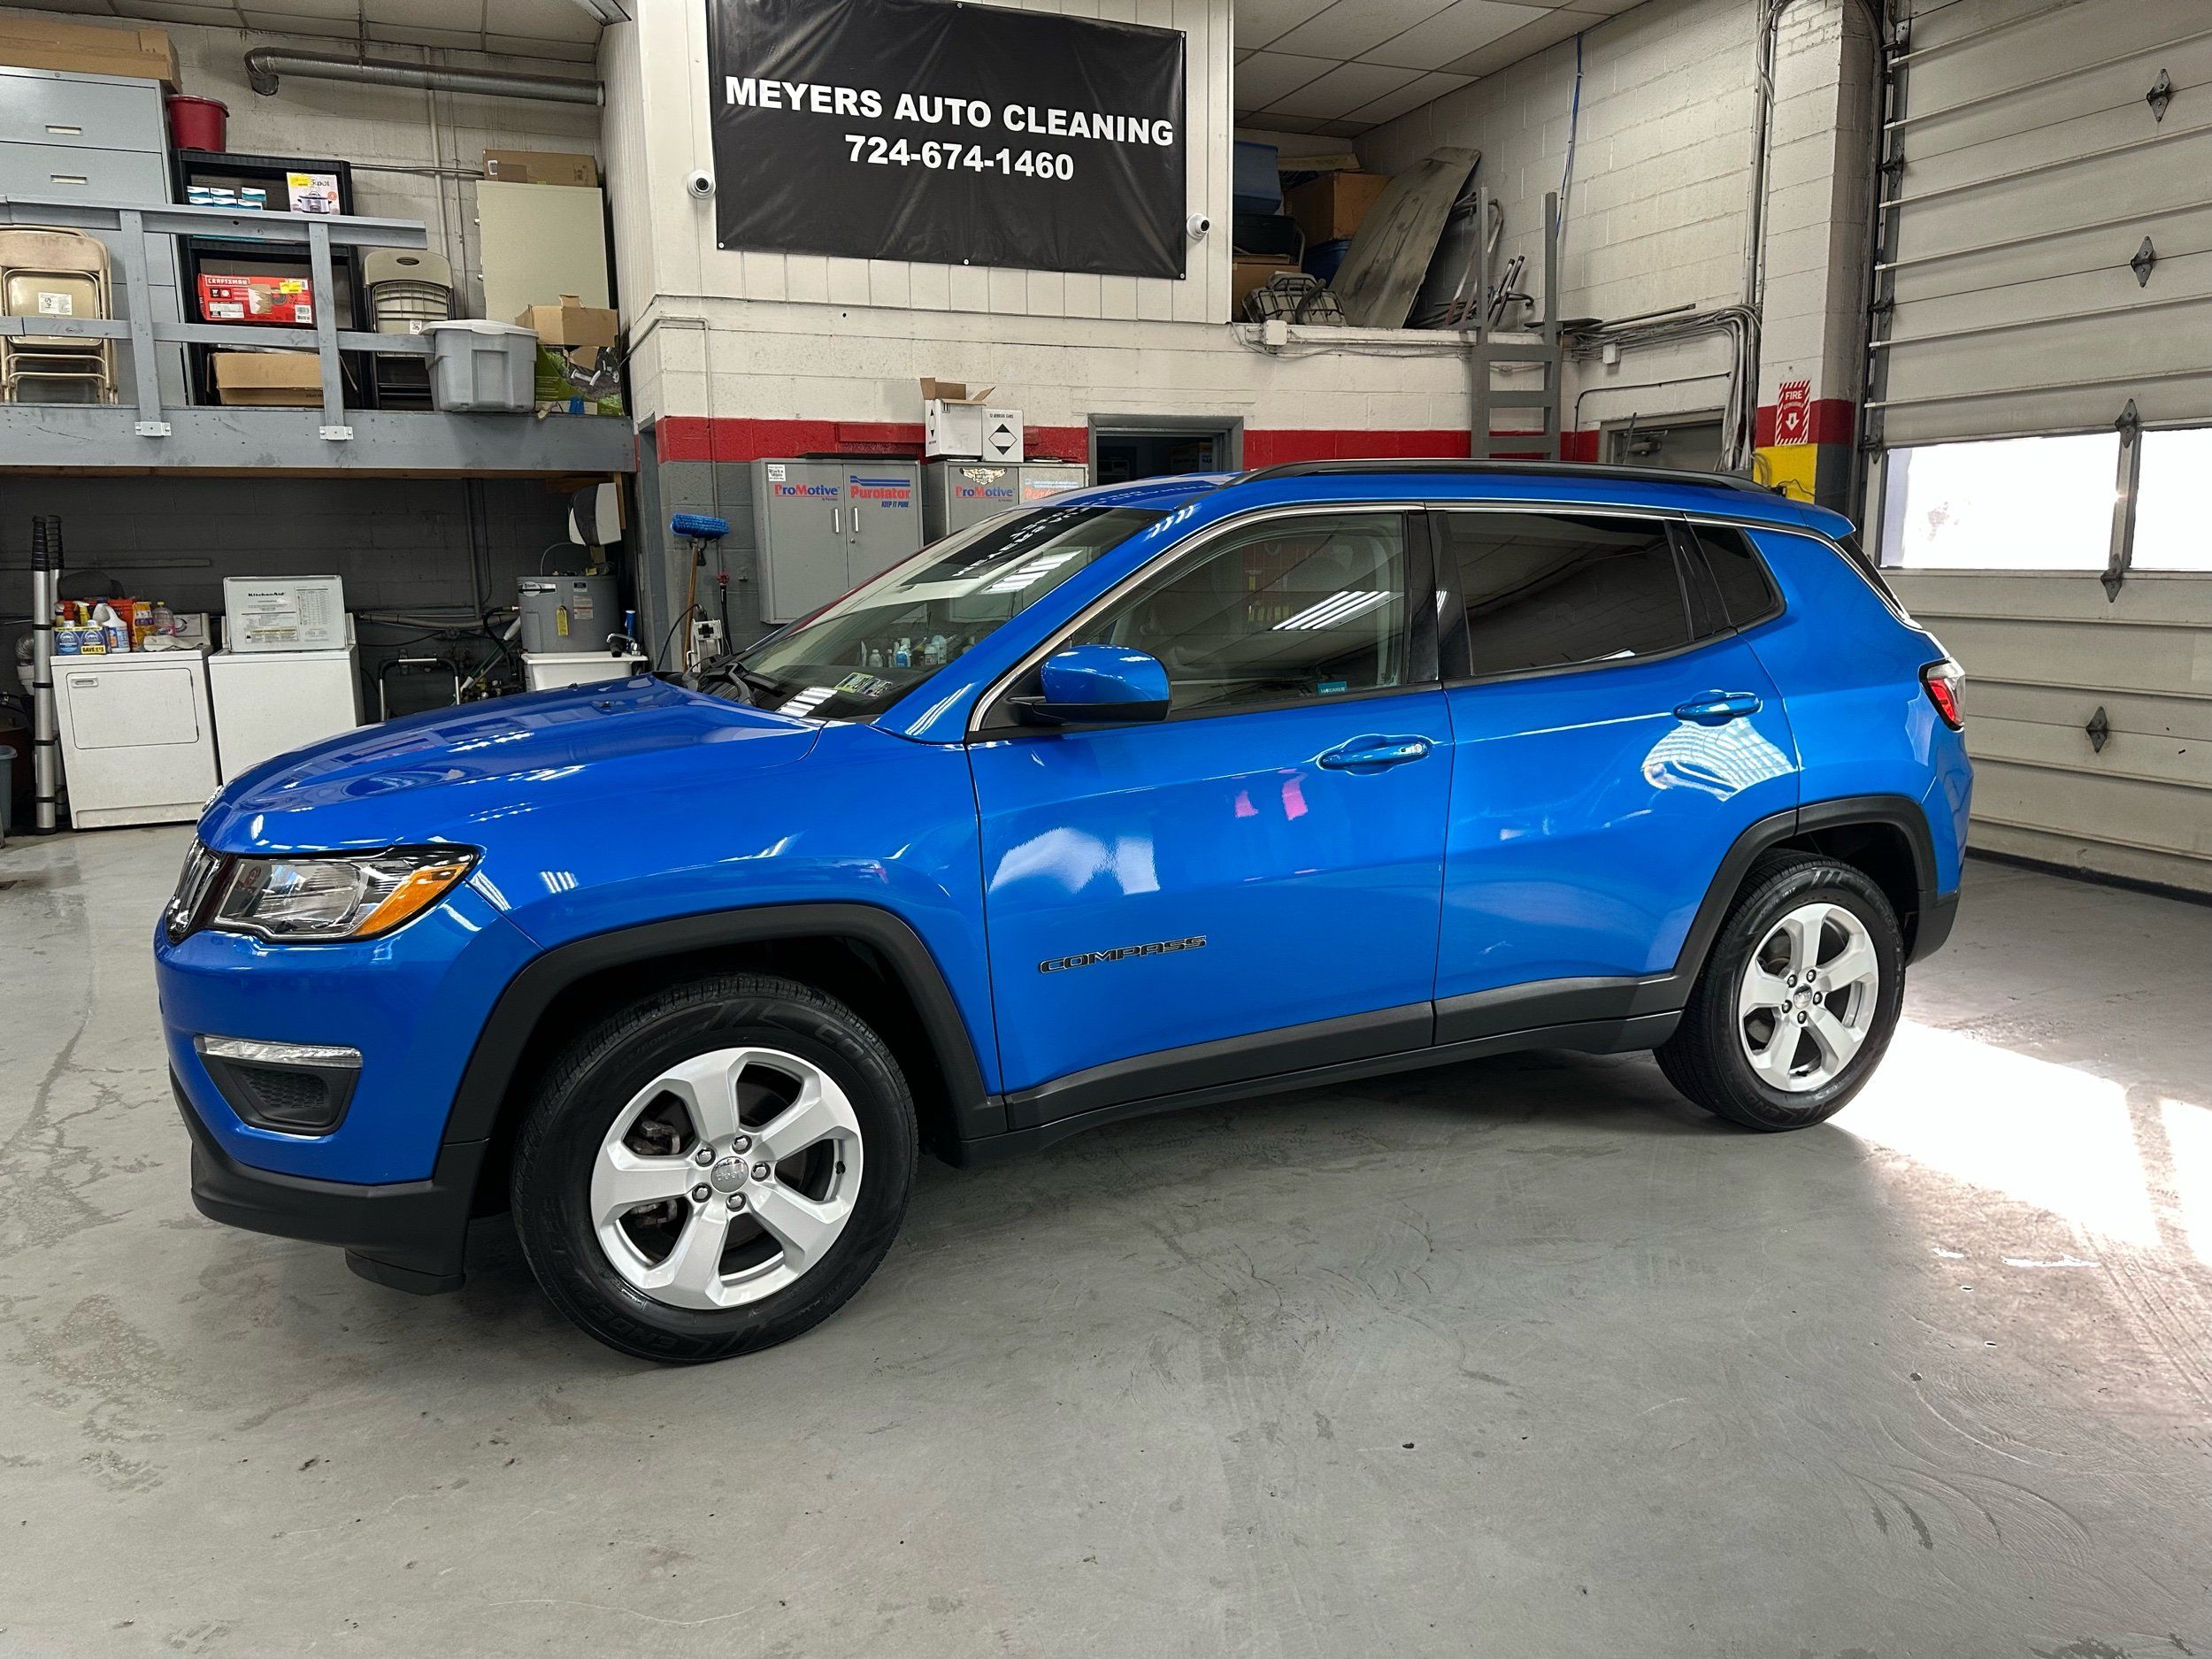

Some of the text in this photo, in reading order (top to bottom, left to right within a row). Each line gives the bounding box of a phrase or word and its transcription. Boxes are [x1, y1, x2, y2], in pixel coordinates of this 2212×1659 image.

[726, 75, 1174, 147] MEYERS AUTO CLEANING
[845, 134, 1074, 180] 724-674-1460
[1786, 390, 1803, 401] FIRE
[773, 483, 839, 495] ProMotive
[850, 486, 910, 499] Purolator
[955, 486, 1014, 497] ProMotive
[1041, 935, 1207, 974] COMPASS
